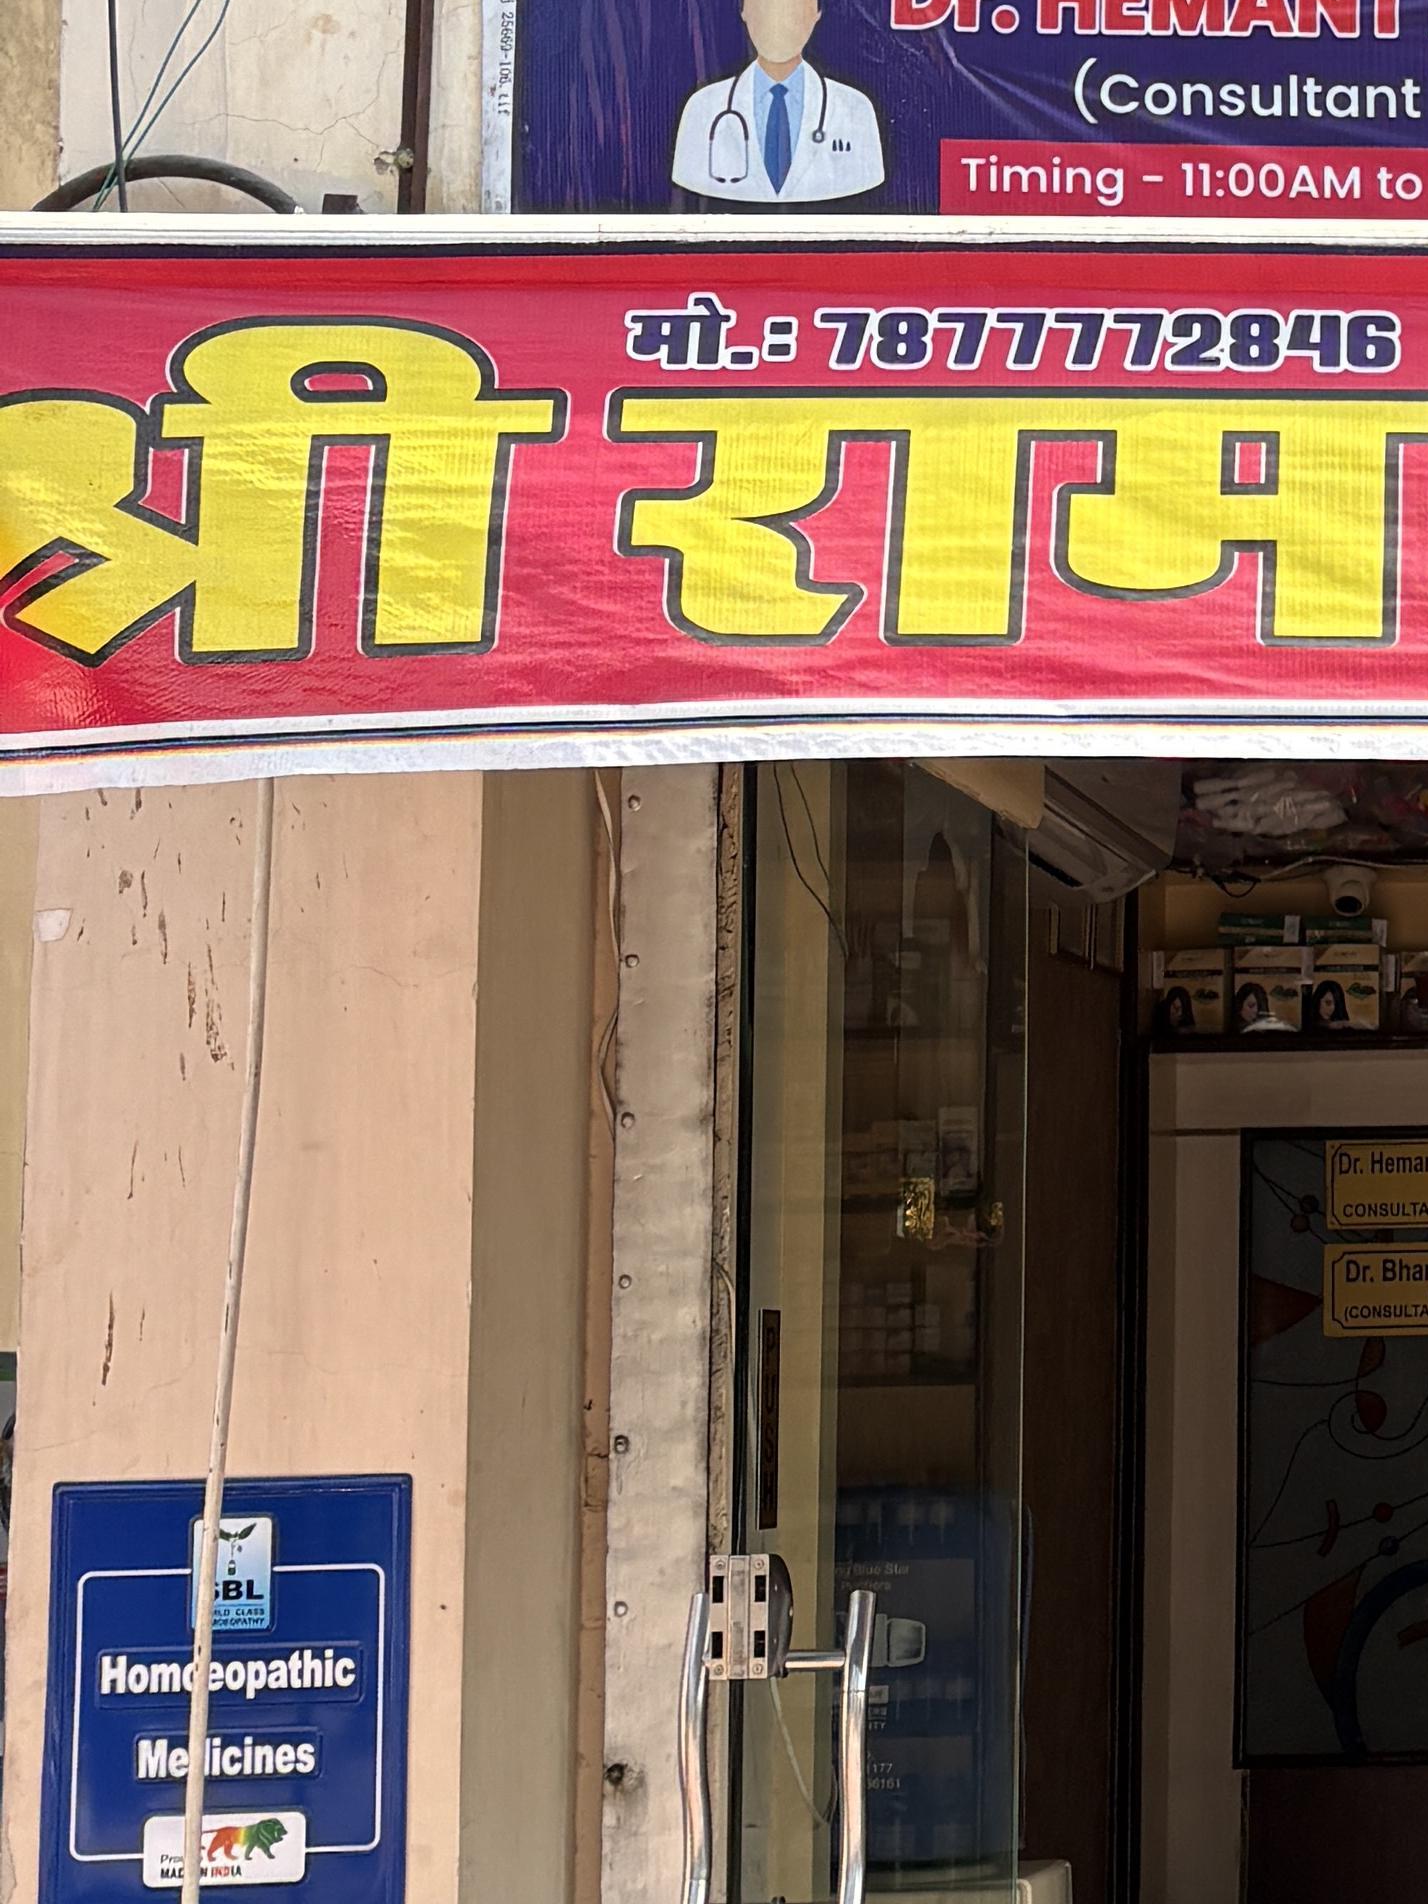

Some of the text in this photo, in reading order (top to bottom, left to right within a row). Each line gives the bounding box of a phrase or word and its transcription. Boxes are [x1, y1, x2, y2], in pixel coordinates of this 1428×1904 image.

[1073, 56, 1420, 124] (Consultant
[961, 155, 1126, 207] Timing
[1180, 161, 1361, 201] 11:00AM
[1376, 165, 1423, 202] to
[812, 307, 1403, 375] 7877772846
[0, 314, 567, 667] श्री
[1339, 1152, 1363, 1174] Dr.
[1345, 1260, 1375, 1283] Dr.
[215, 1579, 264, 1600] BL
